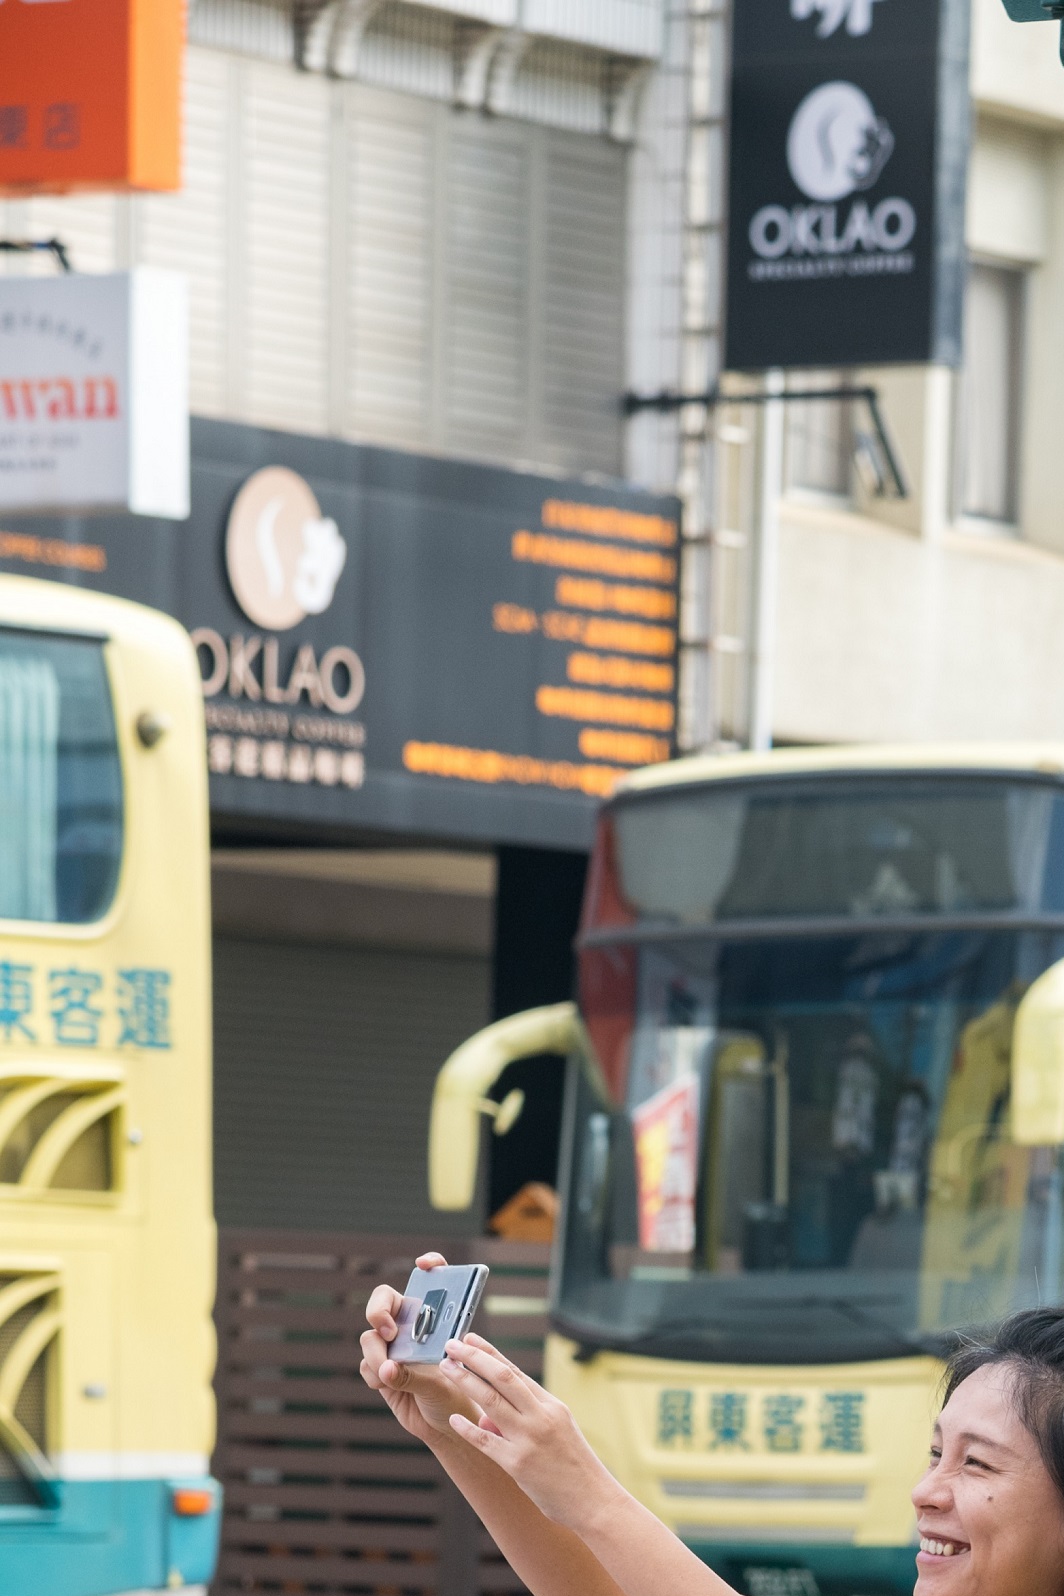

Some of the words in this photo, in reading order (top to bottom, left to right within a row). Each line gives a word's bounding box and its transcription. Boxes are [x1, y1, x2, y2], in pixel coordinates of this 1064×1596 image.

[749, 197, 916, 259] OKLAO
[189, 627, 365, 714] OKLAO
[658, 1388, 867, 1453] 屏東客運
